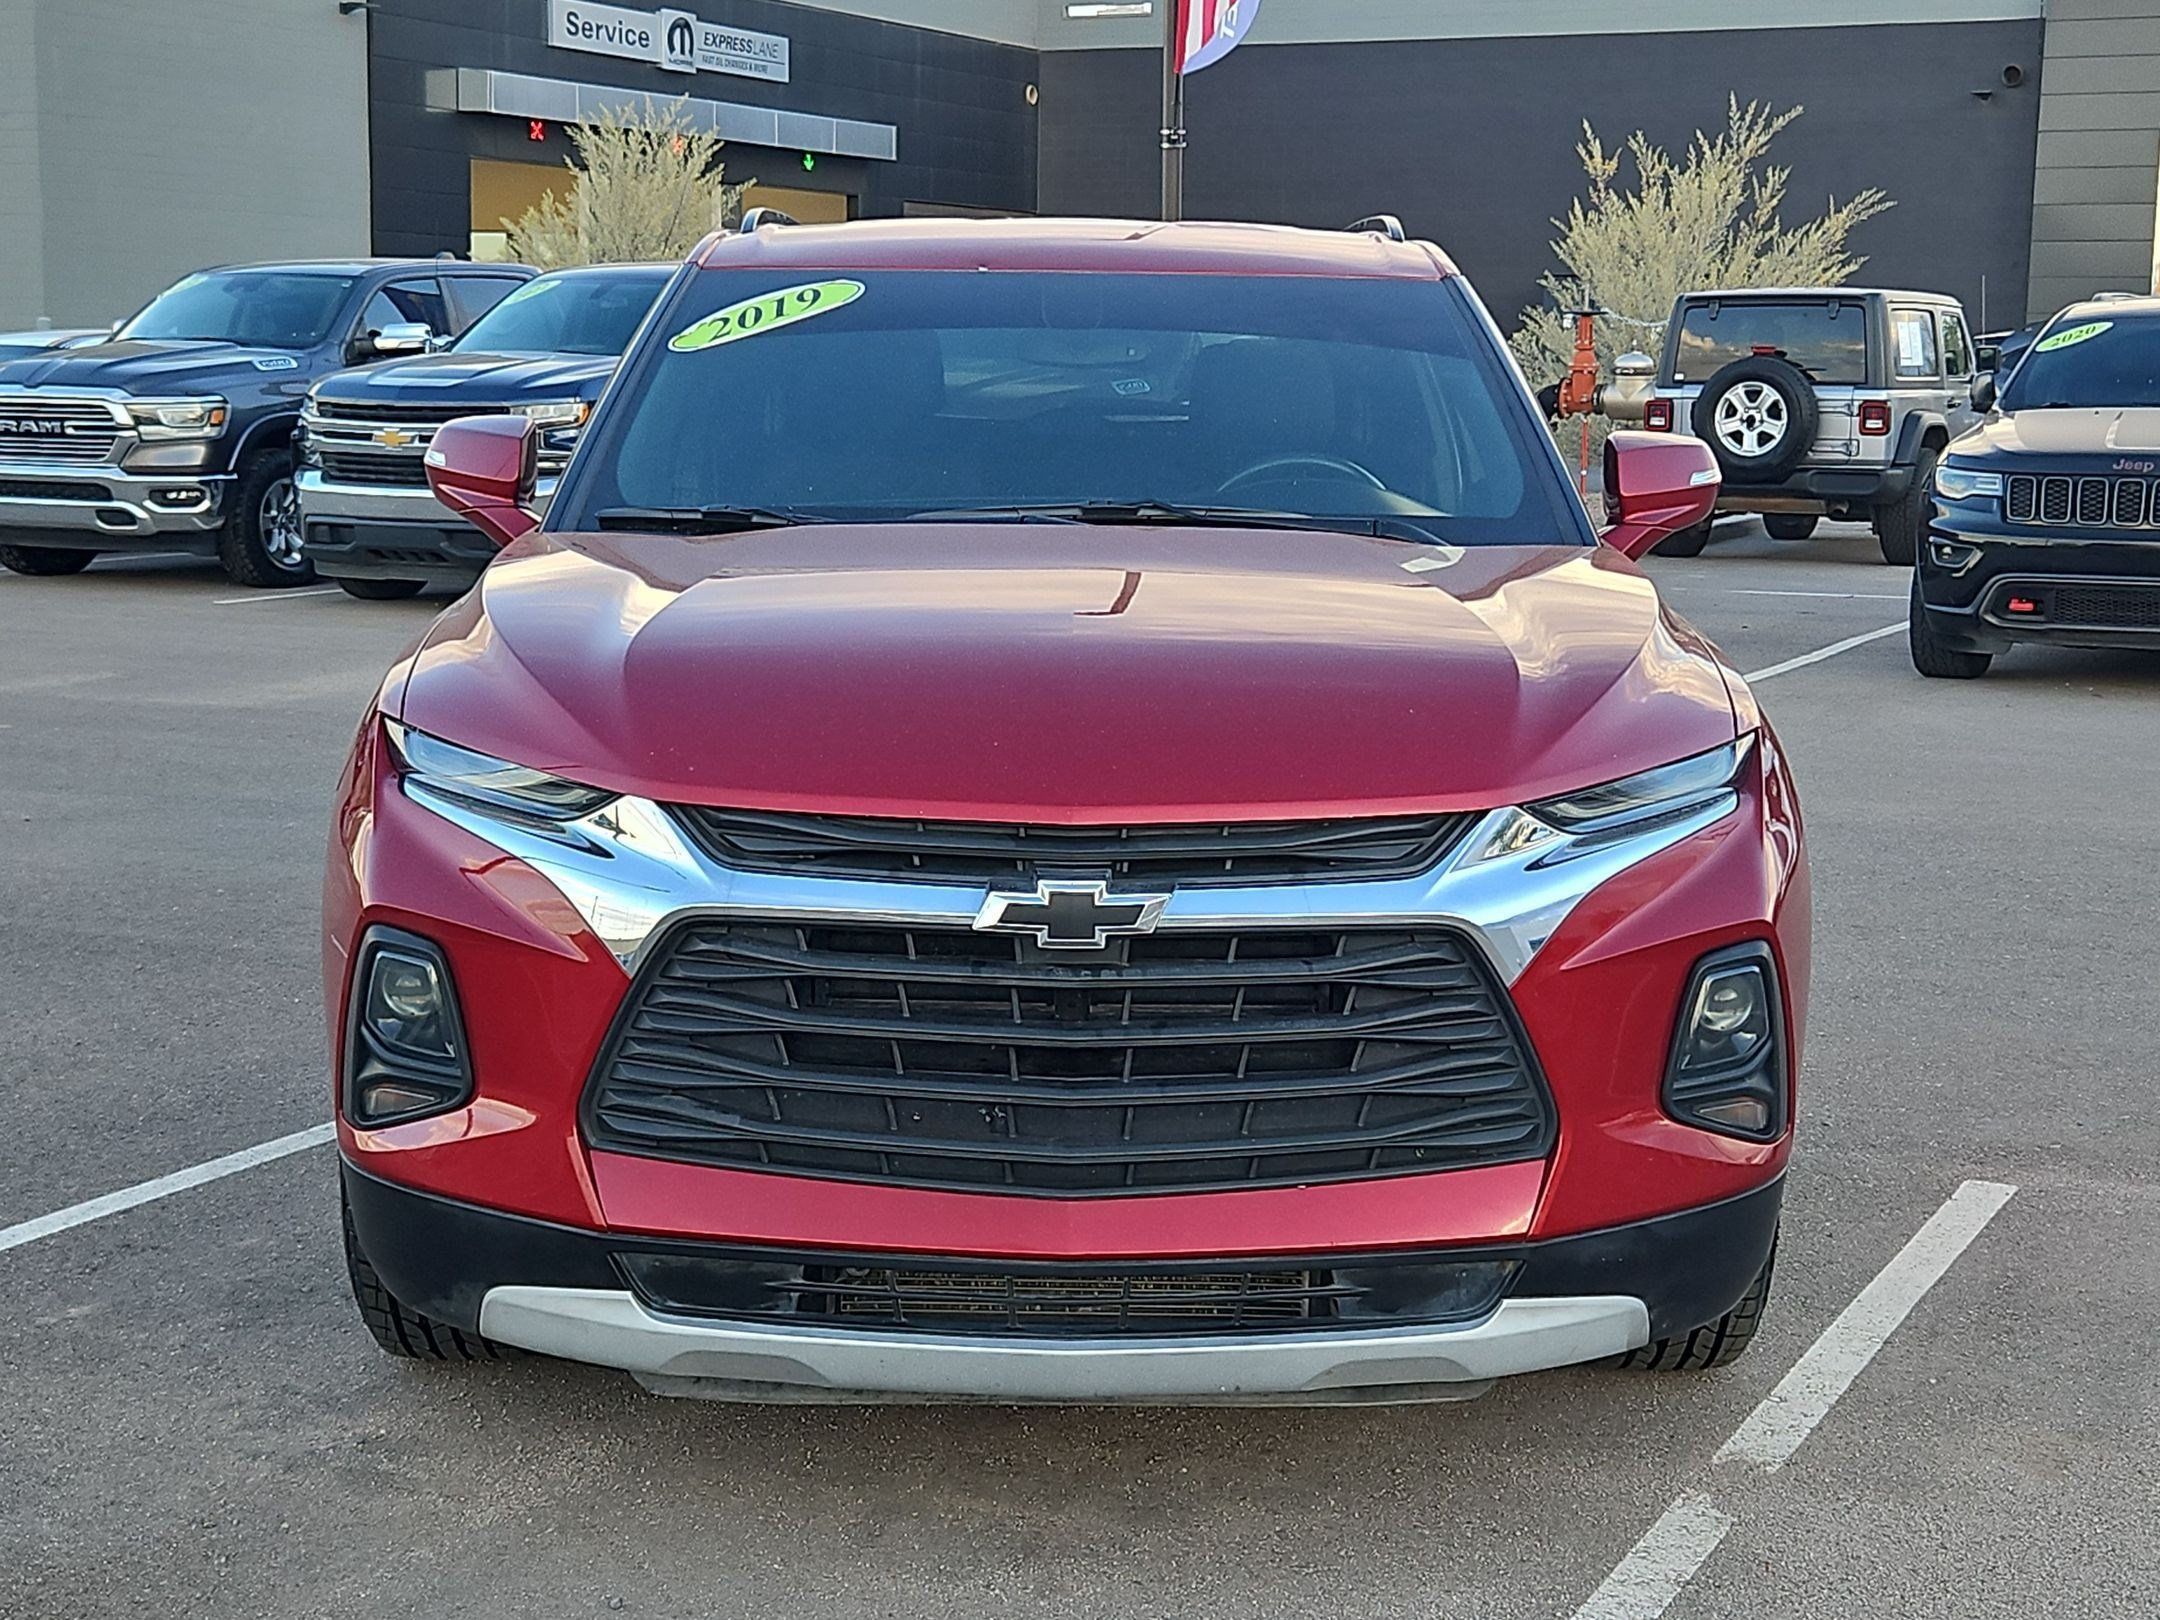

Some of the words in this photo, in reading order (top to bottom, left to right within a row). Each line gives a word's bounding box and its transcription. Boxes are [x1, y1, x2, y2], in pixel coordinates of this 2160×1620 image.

[566, 11, 651, 48] Service
[708, 287, 822, 342] 2019
[2050, 325, 2097, 348] 2020
[0, 419, 62, 434] RAM
[2112, 458, 2154, 473] Jeep
